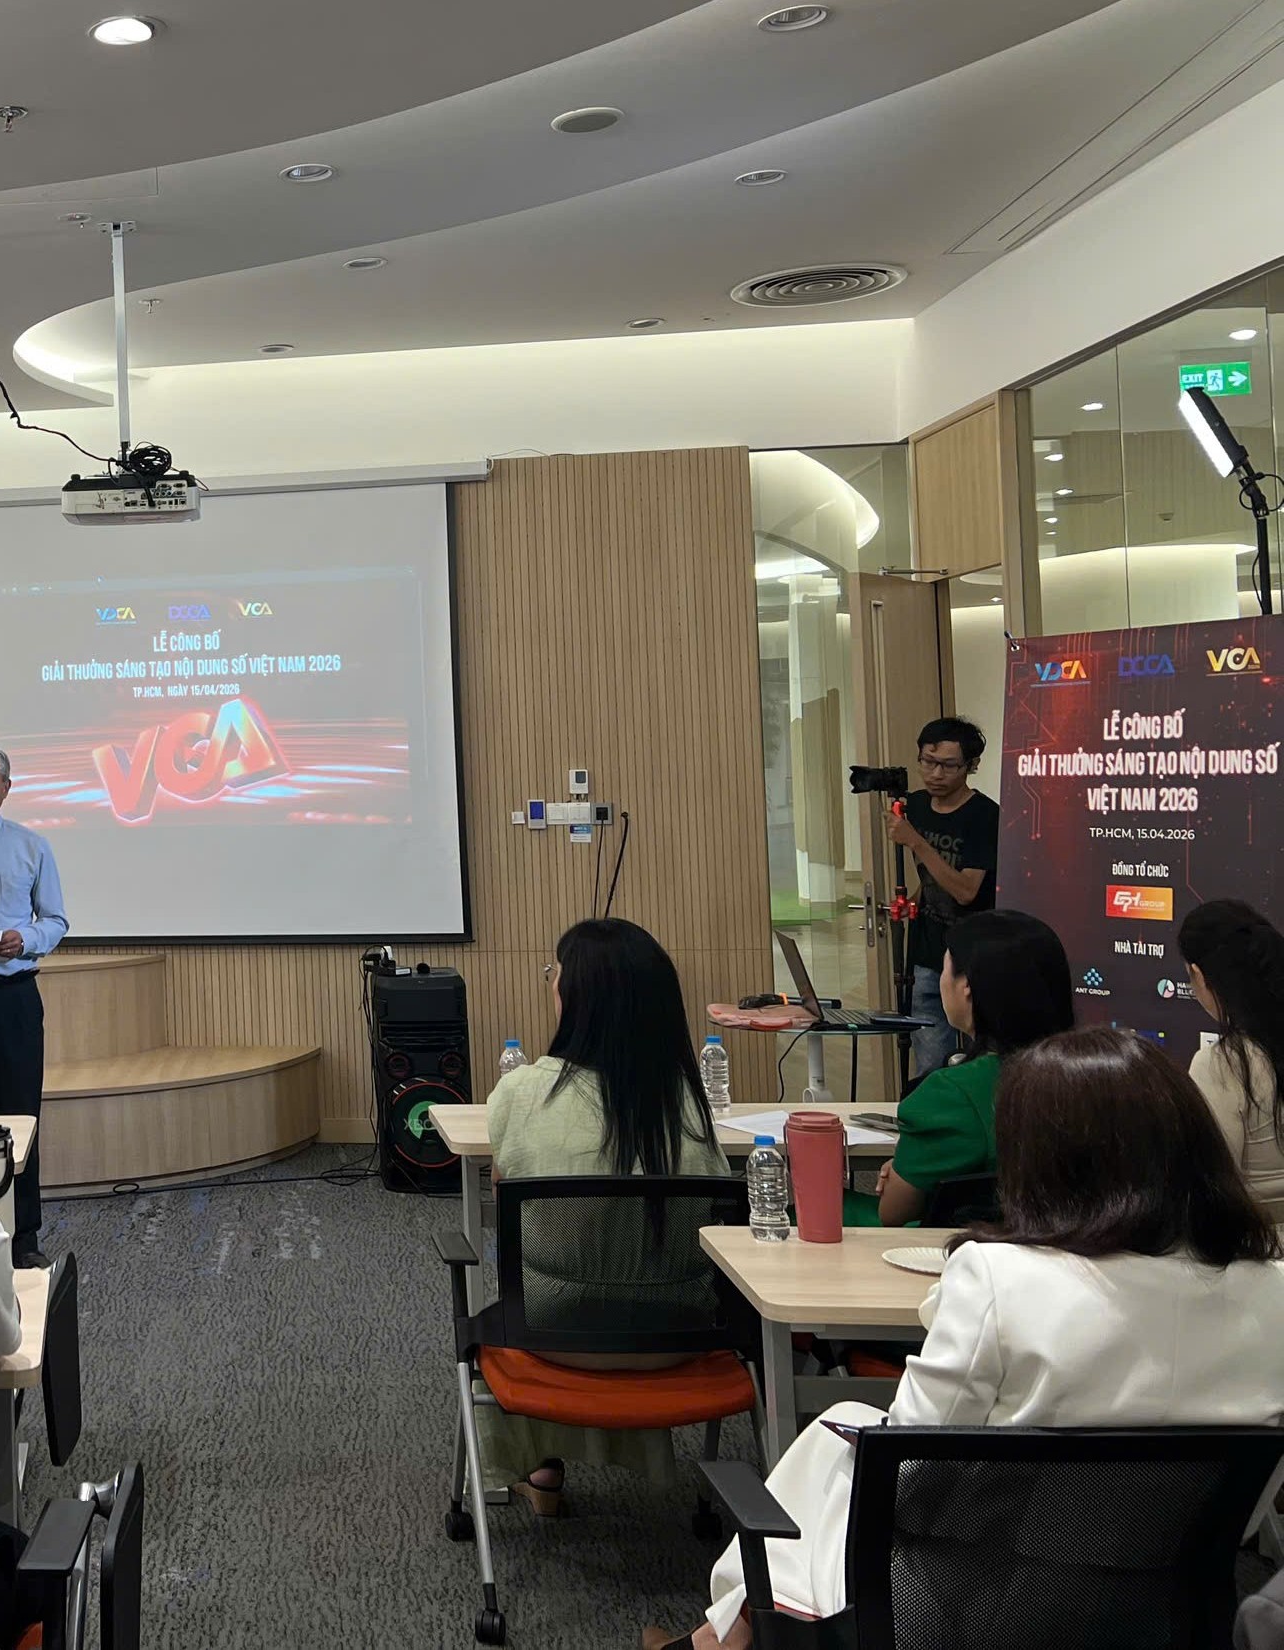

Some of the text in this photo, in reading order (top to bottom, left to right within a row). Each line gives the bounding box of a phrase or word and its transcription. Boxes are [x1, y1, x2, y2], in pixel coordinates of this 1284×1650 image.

[1182, 373, 1204, 383] EXIT
[238, 602, 273, 617] VCA
[153, 629, 222, 653] LỄ CÔNG BỐ
[41, 660, 65, 682] GIẢI
[116, 659, 146, 679] SÁNG
[149, 660, 171, 680] TẠO
[174, 656, 194, 679] NỘI
[197, 658, 229, 676] DUNG
[231, 653, 248, 675] SỐ
[249, 654, 275, 677] VIỆT
[278, 655, 306, 673] NAM
[308, 654, 342, 672] 2026
[1206, 647, 1261, 672] VCA
[167, 683, 189, 697] NGÀY
[191, 683, 240, 696] 15/04/2026
[1103, 708, 1186, 741] LỄ CÔNG BỐ
[92, 698, 292, 822] VCA
[1018, 747, 1046, 777] GIẢI
[1105, 748, 1145, 776] SÁNG
[1147, 751, 1178, 780] TẠO
[1179, 747, 1206, 779] NỘI
[1209, 749, 1252, 775] DUNG
[1255, 741, 1281, 774] SỐ
[1087, 783, 1199, 815] VIỆT NAM 2026
[1089, 827, 1196, 841] TP.HCM, 15.04.2026
[1112, 860, 1134, 877] ĐỒNG
[1135, 860, 1147, 876] TỔ
[1114, 940, 1165, 959] NHÀ TÀI TRỢ
[1088, 988, 1111, 996] GROUP
